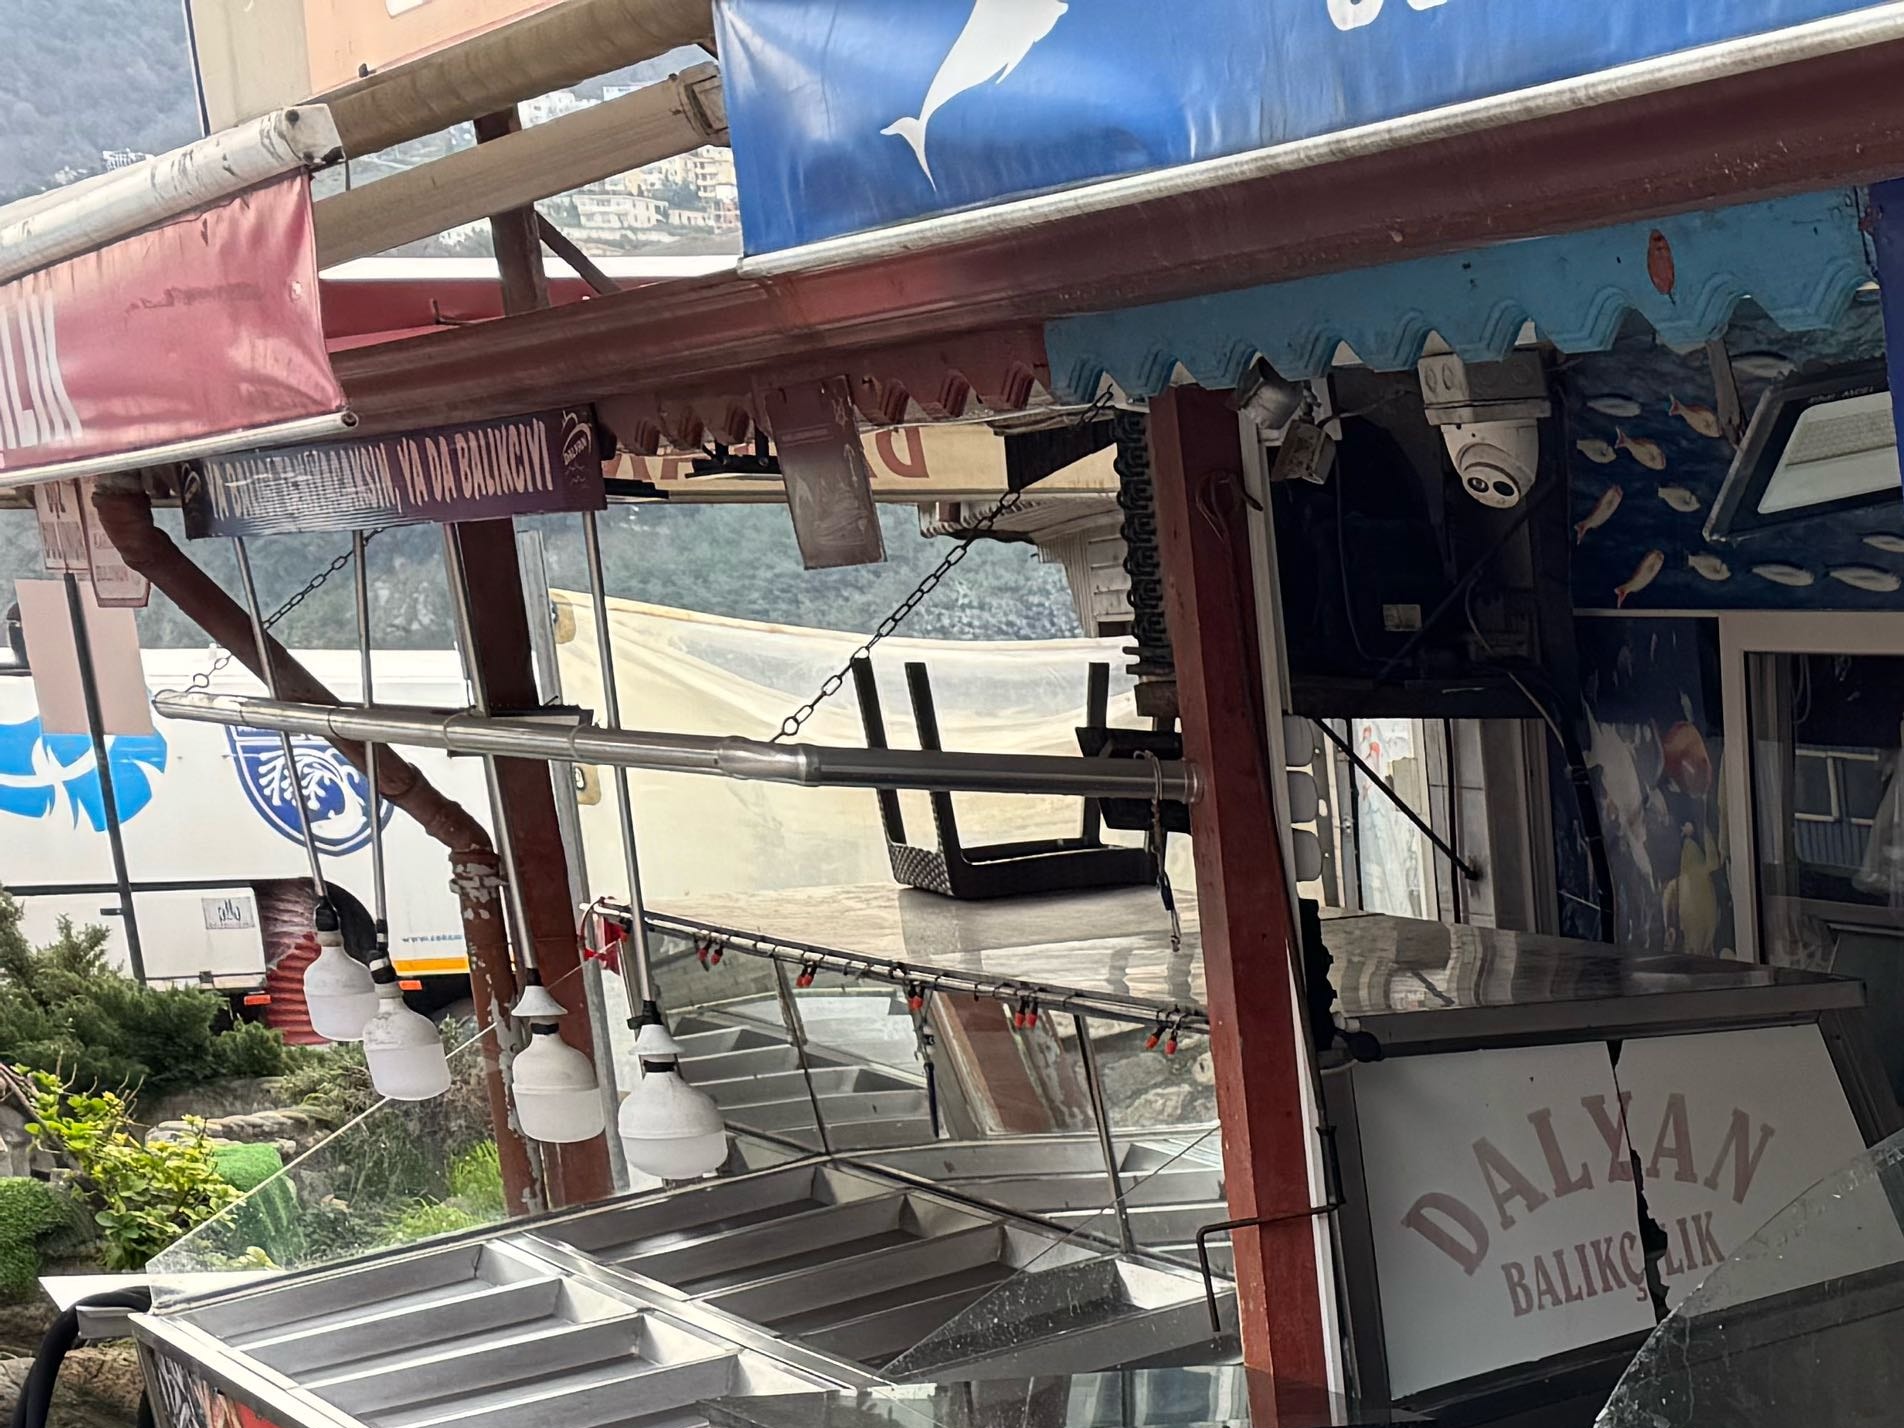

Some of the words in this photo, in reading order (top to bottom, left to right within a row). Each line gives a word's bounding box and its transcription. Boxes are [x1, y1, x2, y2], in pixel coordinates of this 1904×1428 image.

[204, 460, 229, 521] YA
[397, 437, 430, 507] YA
[424, 434, 459, 503] DA
[1400, 1090, 1776, 1277] DALYAN
[1500, 1210, 1725, 1317] BALIKÇLIK
